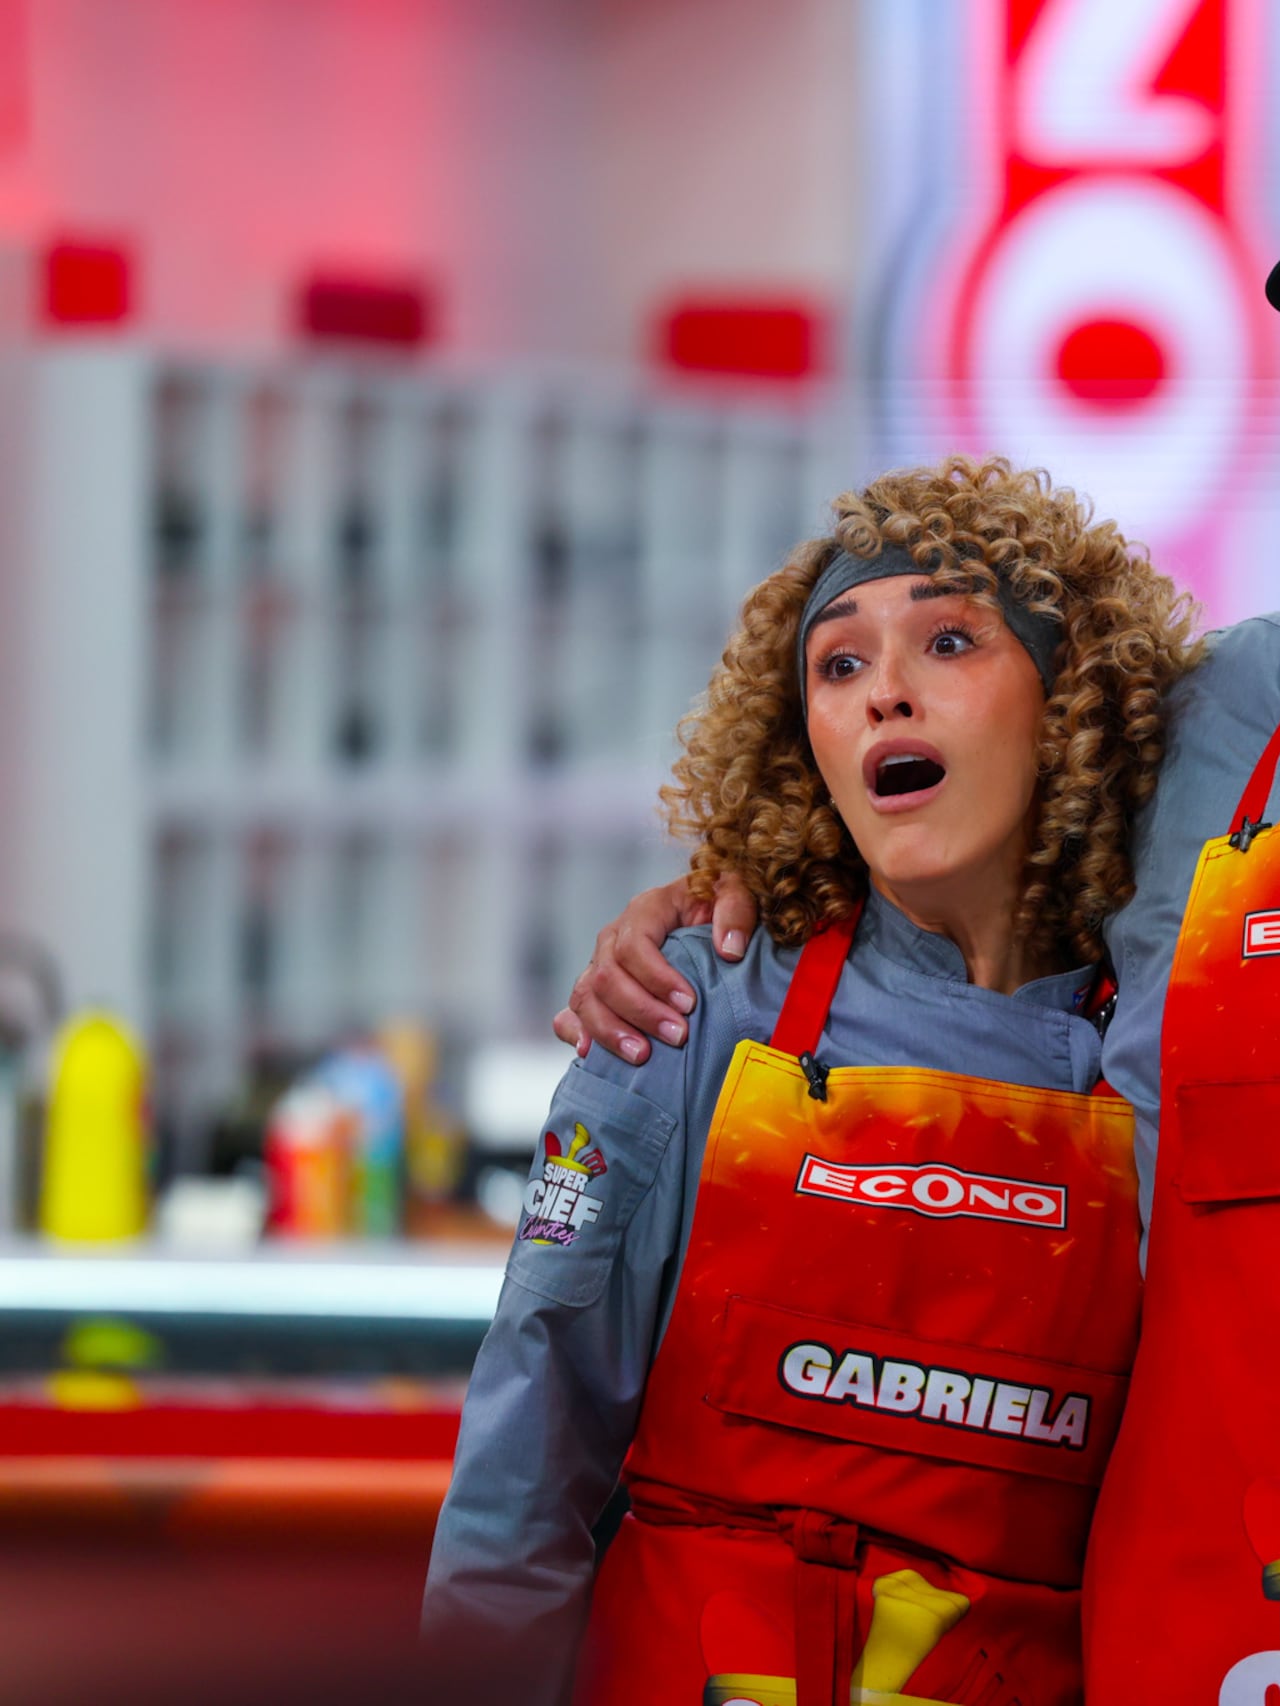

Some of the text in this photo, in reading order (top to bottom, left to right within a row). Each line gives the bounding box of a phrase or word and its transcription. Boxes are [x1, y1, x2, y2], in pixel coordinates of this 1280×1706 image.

[543, 1162, 589, 1193] SUPER
[808, 1165, 1058, 1217] ECONO
[523, 1179, 604, 1231] CHEF
[783, 1344, 1089, 1447] GABRIELA
